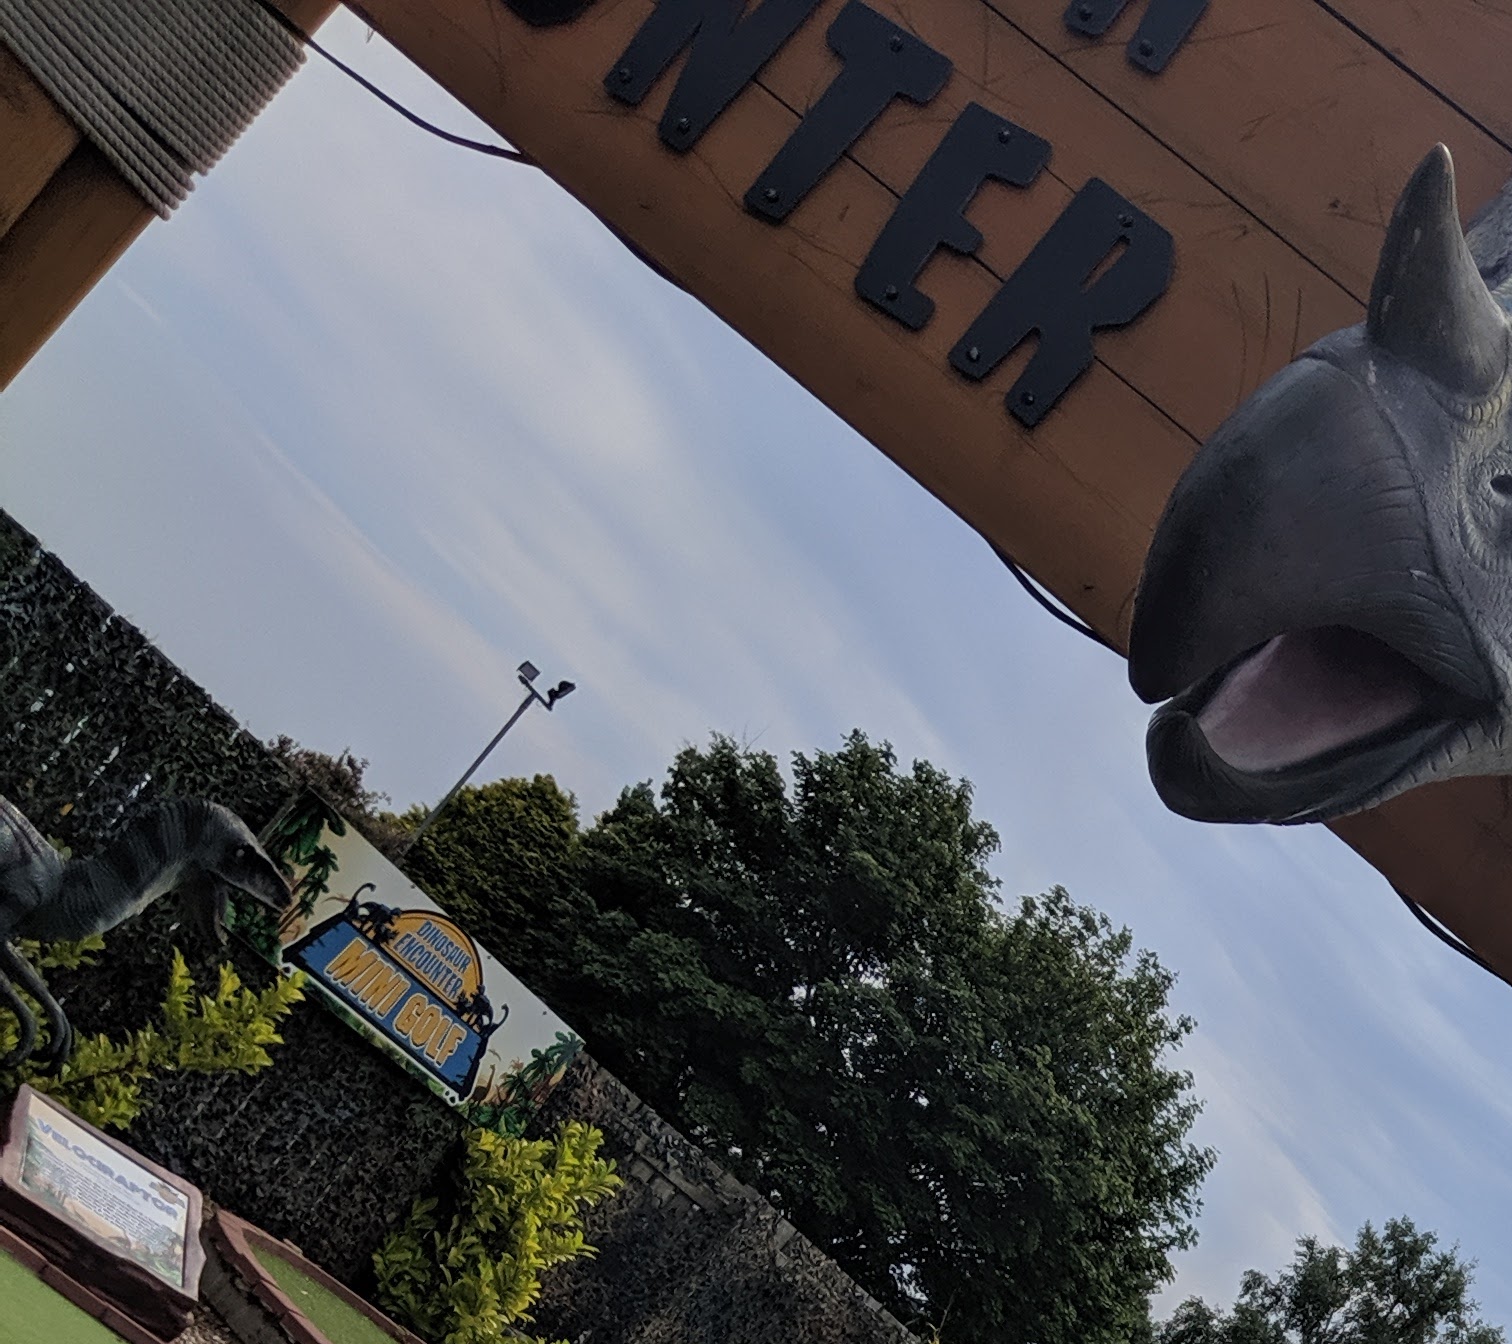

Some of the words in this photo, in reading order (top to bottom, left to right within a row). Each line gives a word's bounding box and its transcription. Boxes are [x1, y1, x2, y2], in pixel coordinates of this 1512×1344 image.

[508, 0, 1176, 429] NTER
[394, 933, 463, 999] ENCOUNTER
[417, 920, 472, 974] DINOSAUR
[324, 937, 411, 1019] MINI
[392, 993, 467, 1068] GOLF
